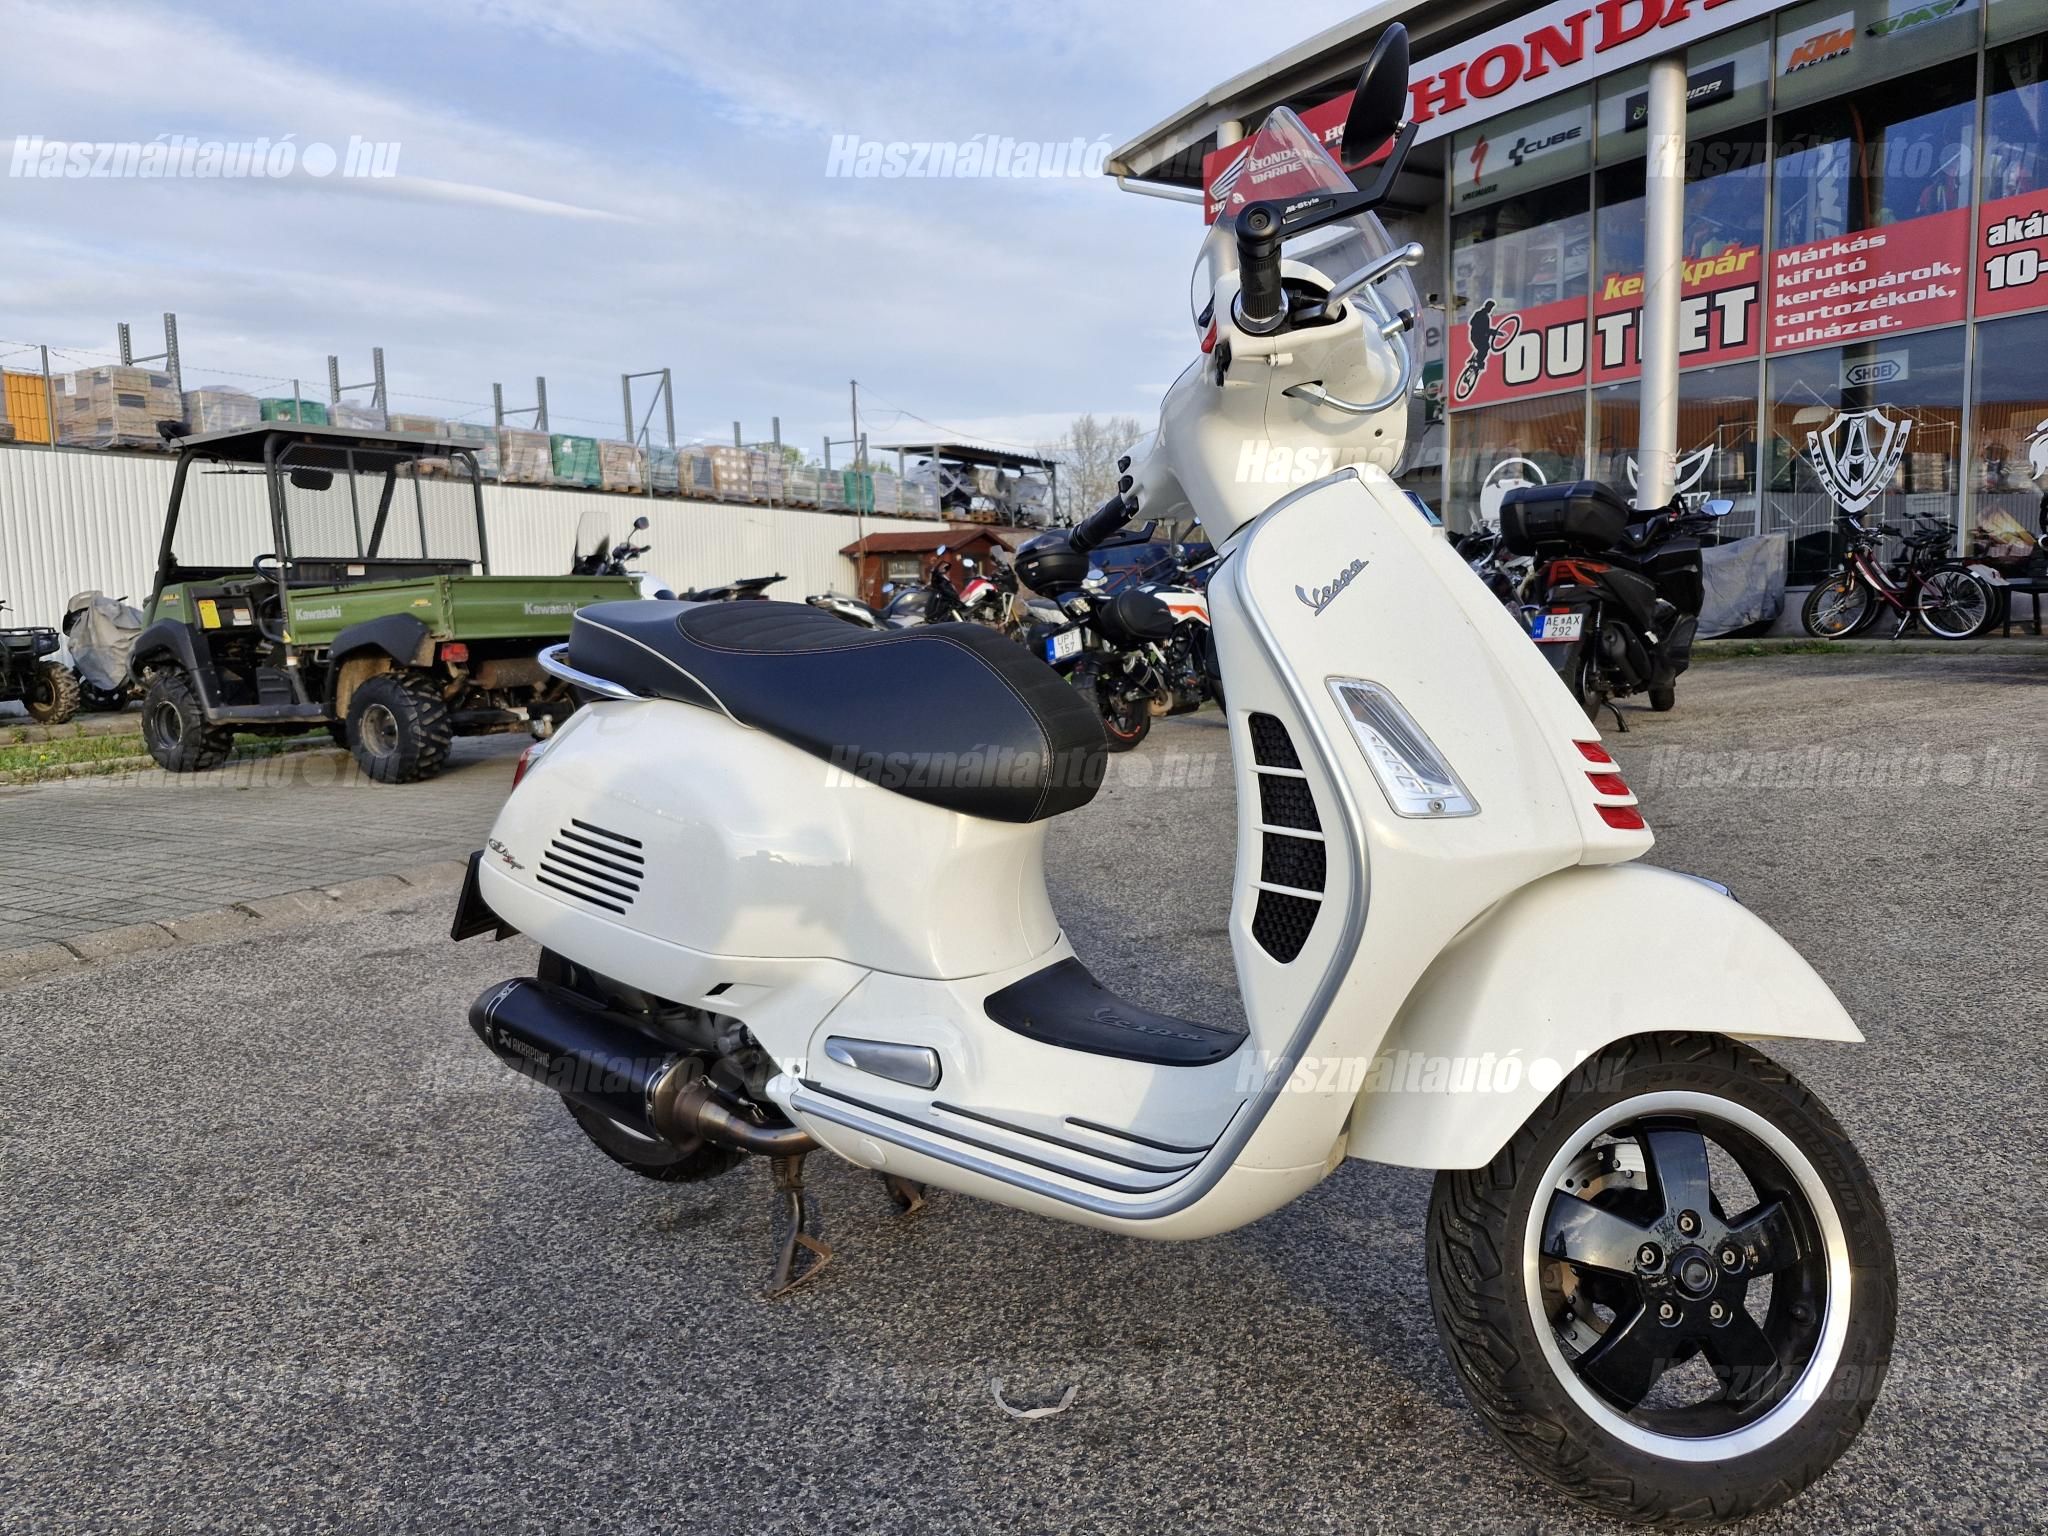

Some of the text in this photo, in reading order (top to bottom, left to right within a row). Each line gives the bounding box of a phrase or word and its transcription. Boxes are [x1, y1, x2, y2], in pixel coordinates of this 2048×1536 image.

[1785, 48, 1850, 75] RACING
[1788, 28, 1857, 69] KTM
[1523, 125, 1583, 154] CUBE
[1777, 234, 1887, 268] Márkás
[1603, 250, 1757, 300] kekpár
[1776, 261, 1962, 308] kerékpárok,
[1777, 257, 1867, 288] kifutó
[1774, 283, 1958, 328] tartozékok,
[1503, 284, 1757, 387] OUTET
[1774, 315, 1904, 347] ruházat.
[1854, 364, 1893, 382] SHOEI
[1808, 432, 1907, 505] ARLEN NESS
[1295, 558, 1370, 617] Vespa
[295, 605, 342, 621] Kawasaki
[1057, 631, 1076, 647] UPT
[1552, 626, 1571, 636] 292
[1060, 641, 1076, 655] 157
